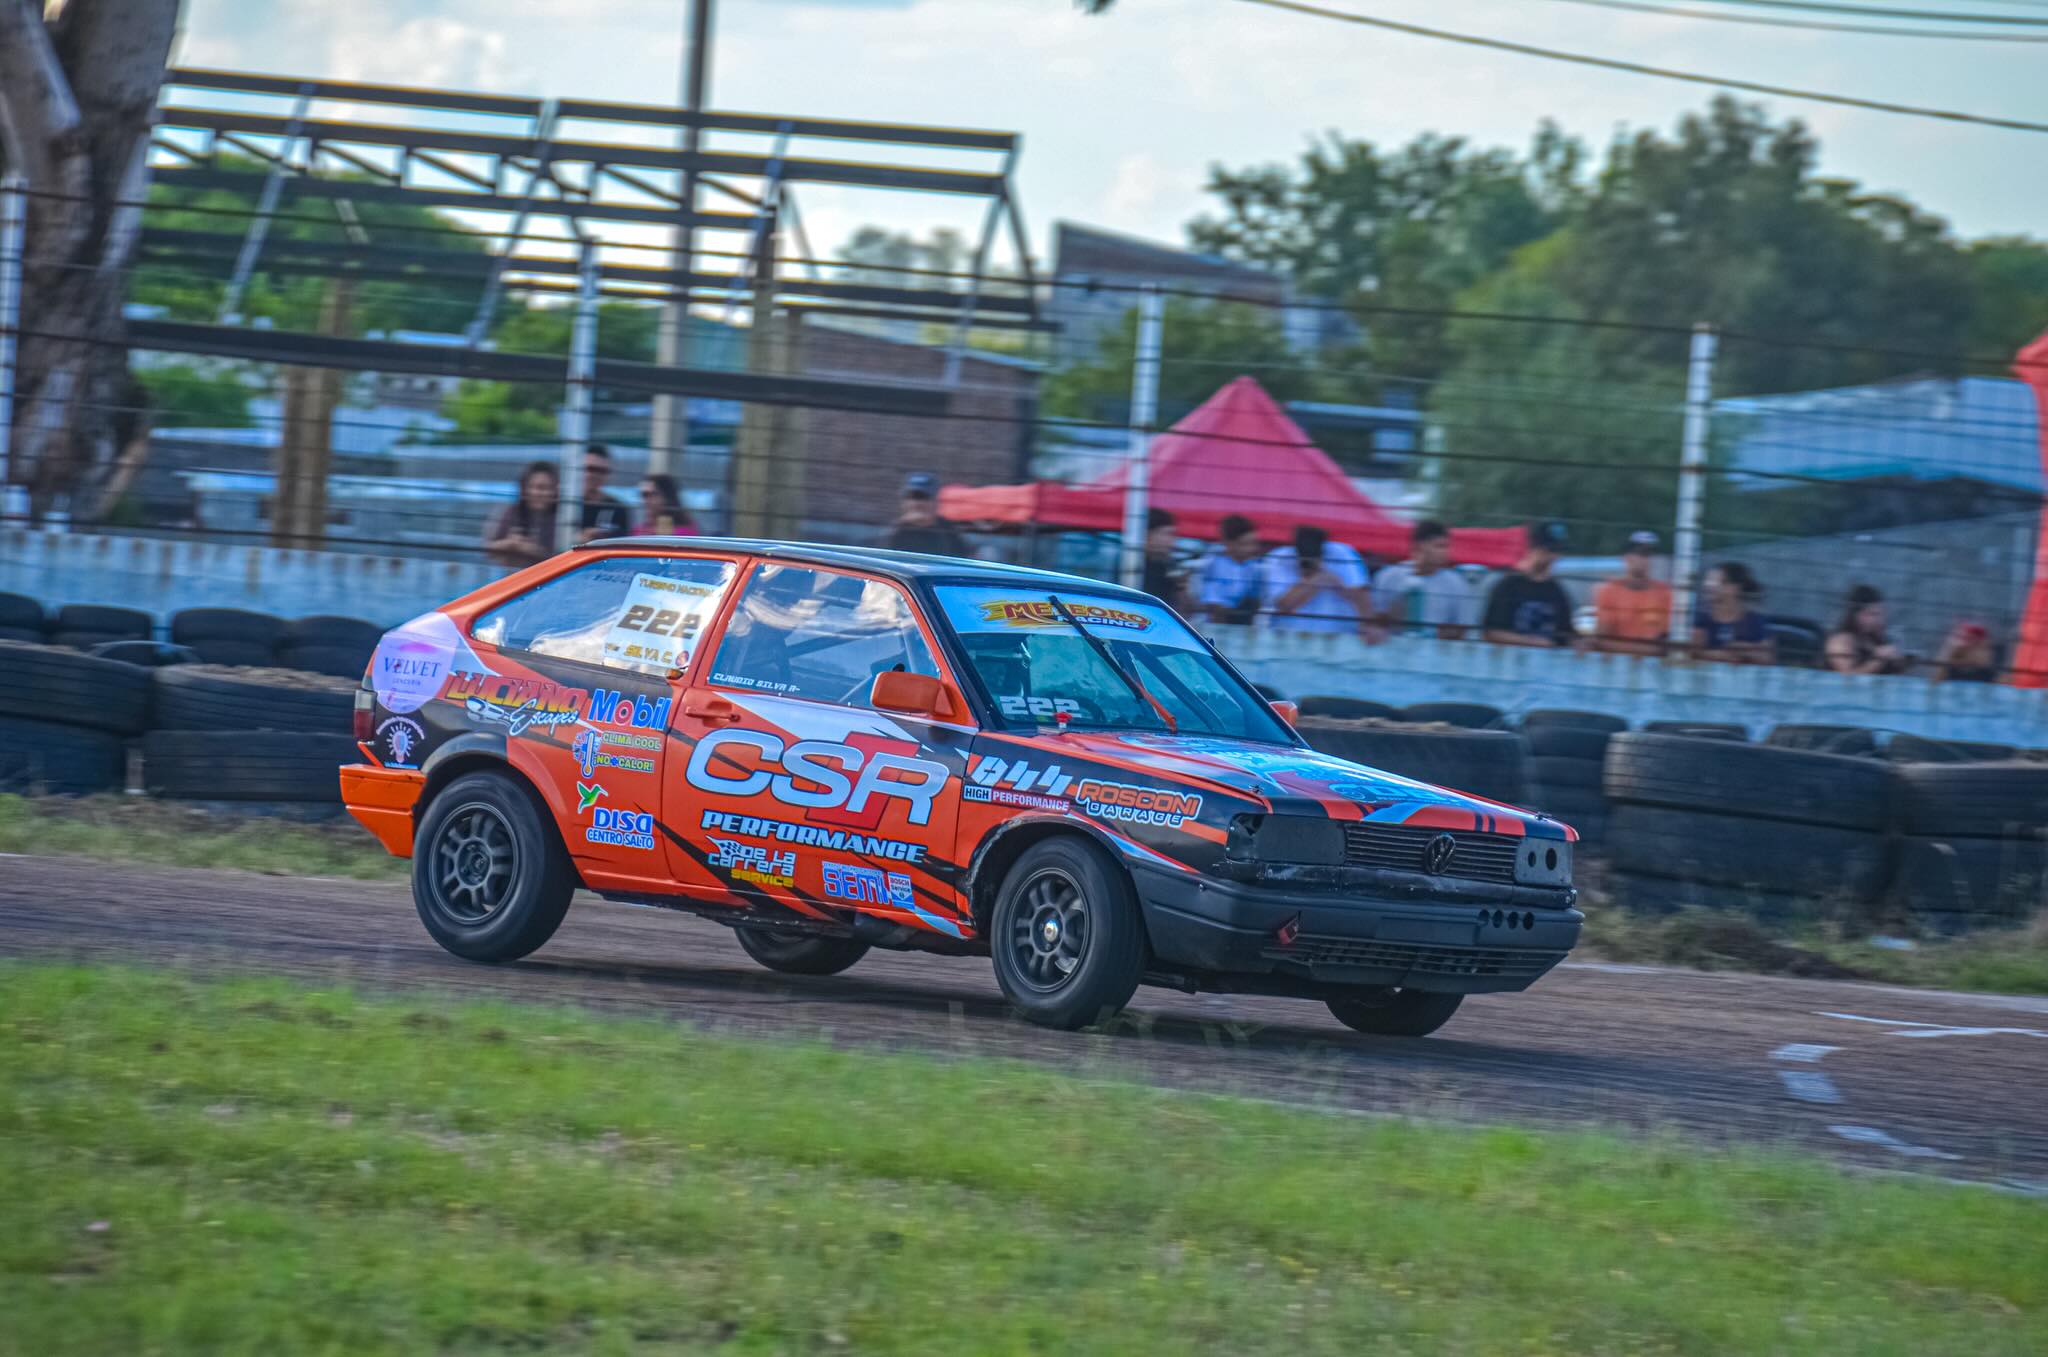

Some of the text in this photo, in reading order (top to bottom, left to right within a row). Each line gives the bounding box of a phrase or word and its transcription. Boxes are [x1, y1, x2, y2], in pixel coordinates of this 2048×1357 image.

[617, 604, 701, 639] 222
[384, 656, 443, 678] VELVET
[445, 670, 589, 713] LUCIANO
[713, 673, 755, 686] CLAUDIO
[756, 680, 787, 691] SILVA
[509, 698, 580, 737] Escapes
[588, 688, 673, 731] Mobil
[1000, 696, 1081, 717] 222
[602, 732, 662, 750] CLIMA COOL
[685, 727, 950, 826] CSR
[965, 785, 1071, 812] HIGH PERFORMANCE
[1079, 782, 1200, 818] ROSCONI
[1089, 802, 1183, 825] GARAGE
[586, 827, 654, 849] CENTRO SALTO
[700, 808, 929, 863] PERFORMANCE
[889, 877, 911, 887] BOSCH
